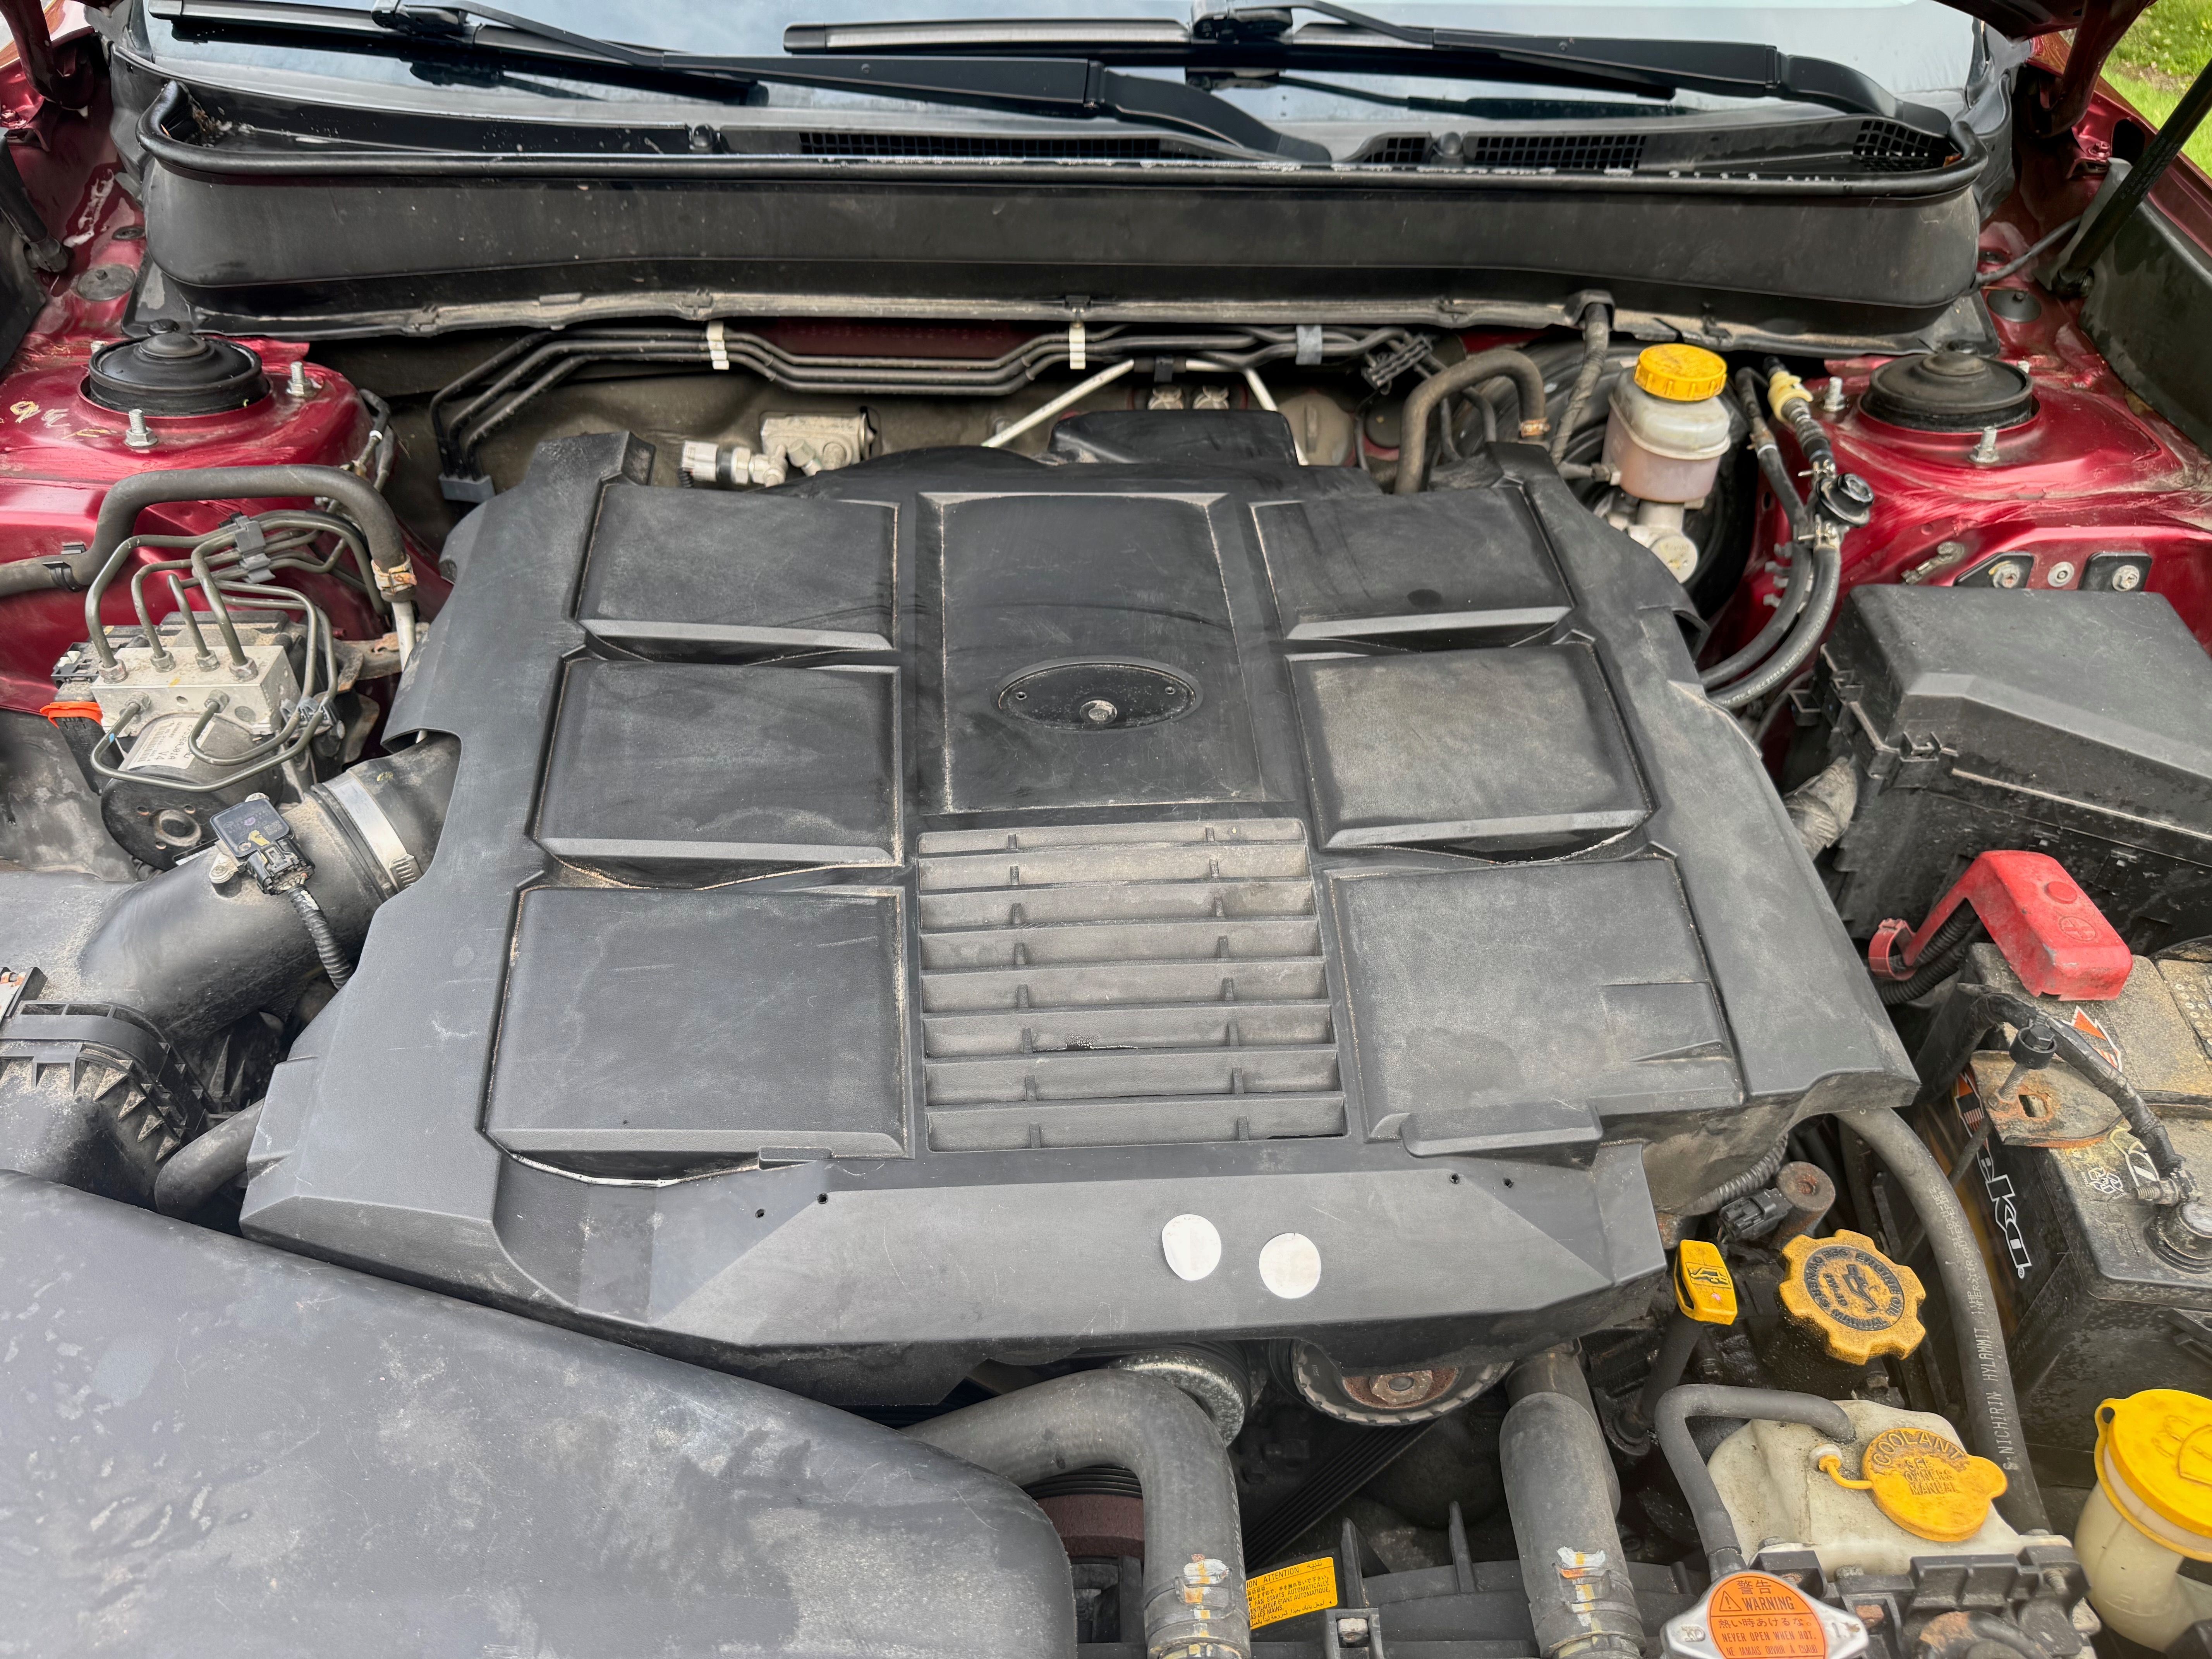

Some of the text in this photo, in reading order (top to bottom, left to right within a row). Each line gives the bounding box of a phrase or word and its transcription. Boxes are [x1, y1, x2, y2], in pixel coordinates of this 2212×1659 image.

[1822, 1248, 1850, 1260] SEE
[1856, 1252, 1901, 1316] ENGINE OIL
[1831, 1308, 1891, 1328] MANUAL
[1973, 1327, 1999, 1381] HYLAMMIT
[1986, 1392, 2015, 1454] NICHIRIN
[1873, 1431, 1965, 1467] COOLANT
[1906, 1459, 1932, 1470] SEE
[1905, 1470, 1954, 1483] OWNERS
[1910, 1481, 1960, 1496] MANUAL
[1263, 1566, 1299, 1583] ATTENTION
[1267, 1592, 1285, 1602] STARTS
[1288, 1580, 1330, 1596] AUTOMATICALLY.
[1736, 1580, 1772, 1595] 警告
[1741, 1595, 1795, 1611] WARNING
[1718, 1616, 1812, 1628] 熱い時あけるな。
[1721, 1630, 1817, 1642] NEVER OPEN WHEN HOT.
[1726, 1647, 1734, 1656] NE
